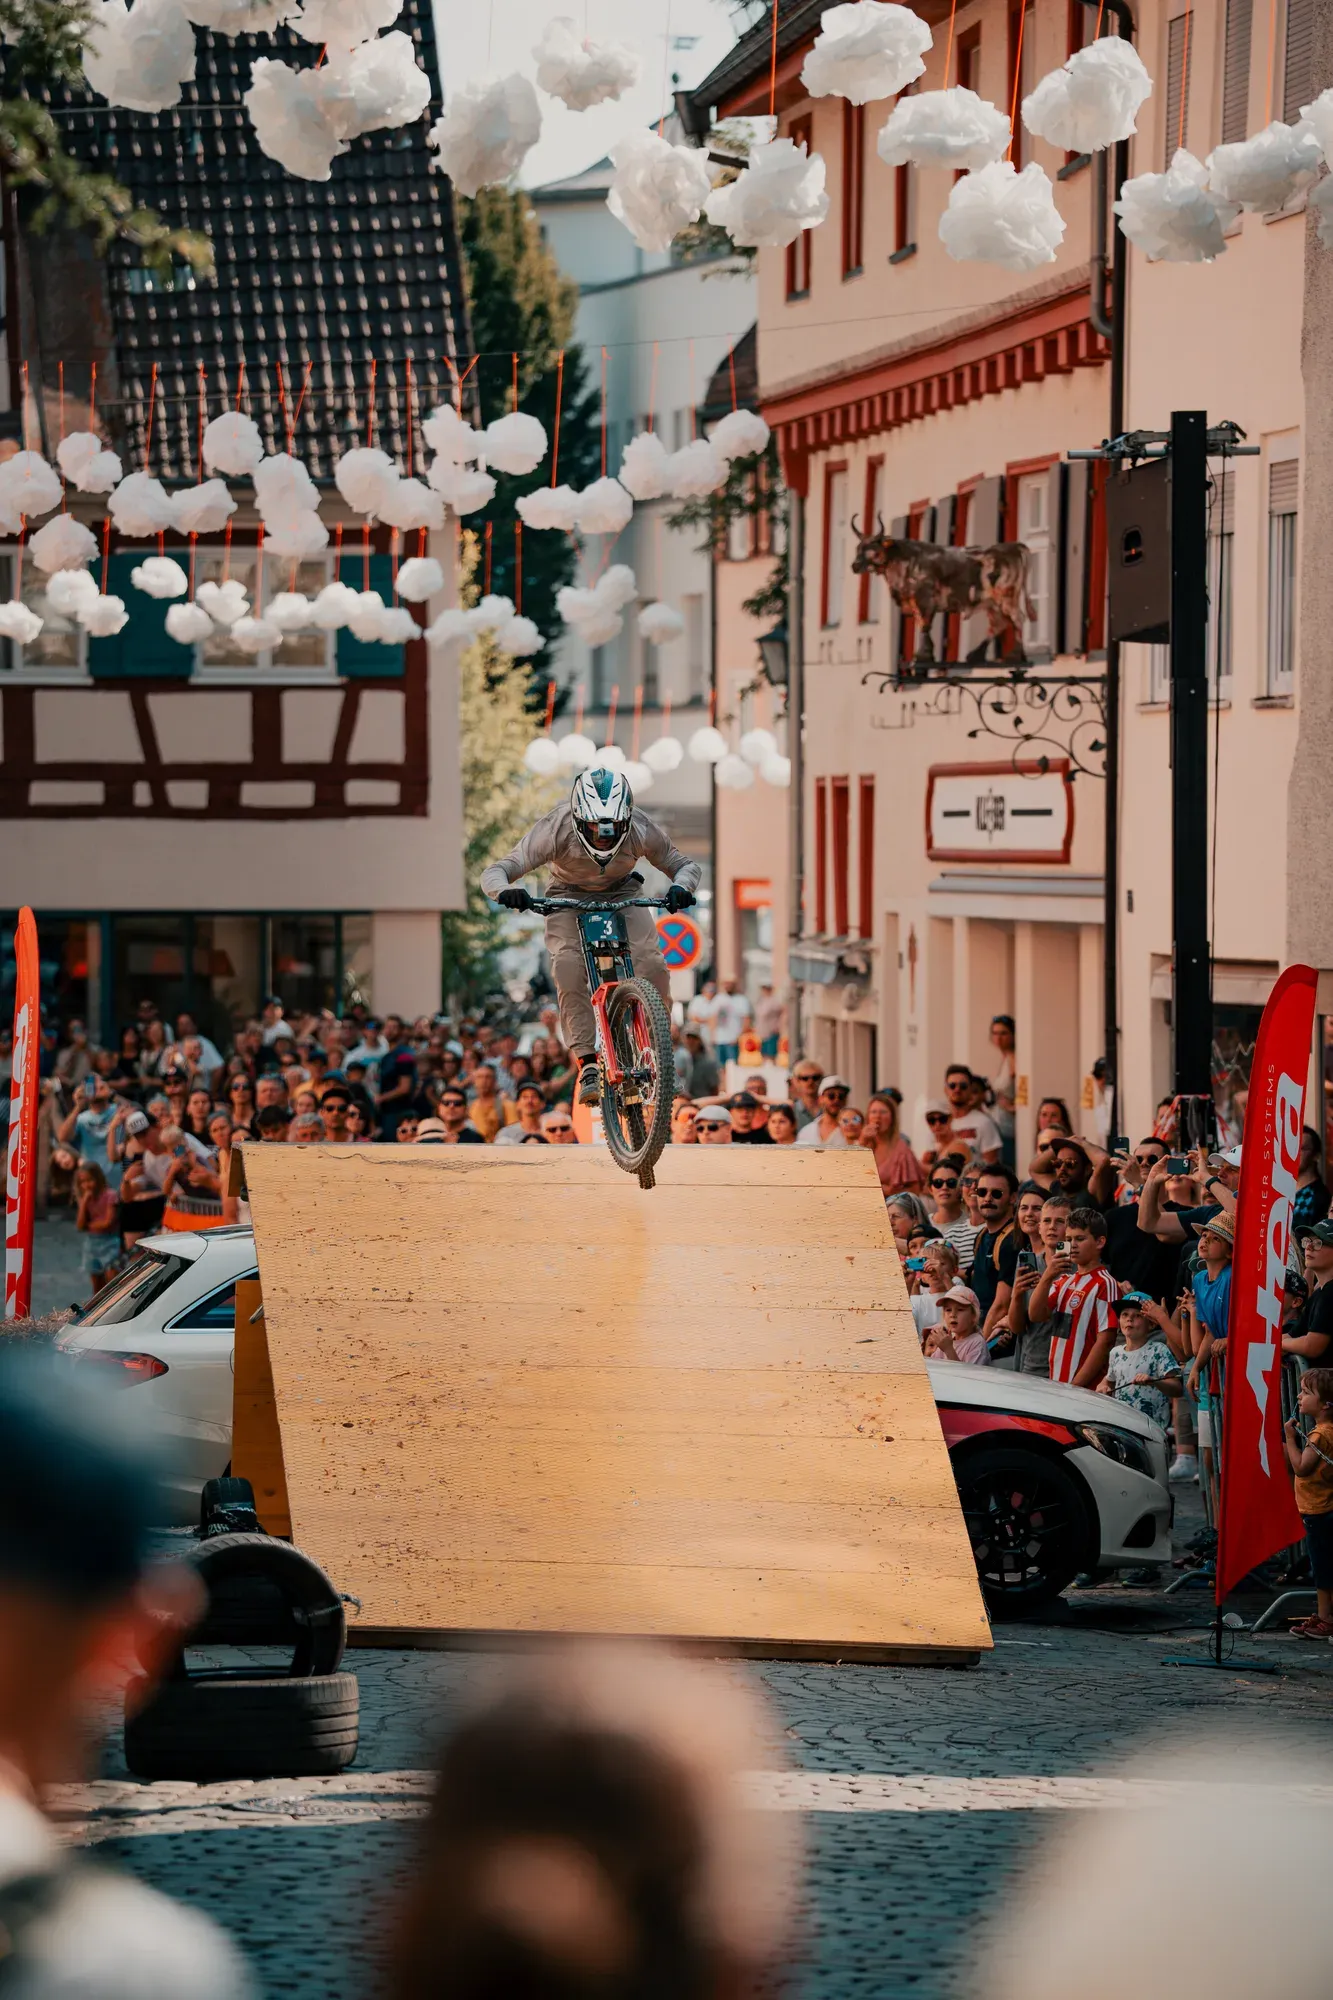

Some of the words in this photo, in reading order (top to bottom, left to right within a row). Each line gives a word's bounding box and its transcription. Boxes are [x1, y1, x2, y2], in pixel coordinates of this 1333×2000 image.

[603, 920, 613, 936] 3
[1263, 1063, 1276, 1160] SYSTEMS
[1257, 1175, 1270, 1272] CARRIER
[1246, 1071, 1304, 1479] Atera
